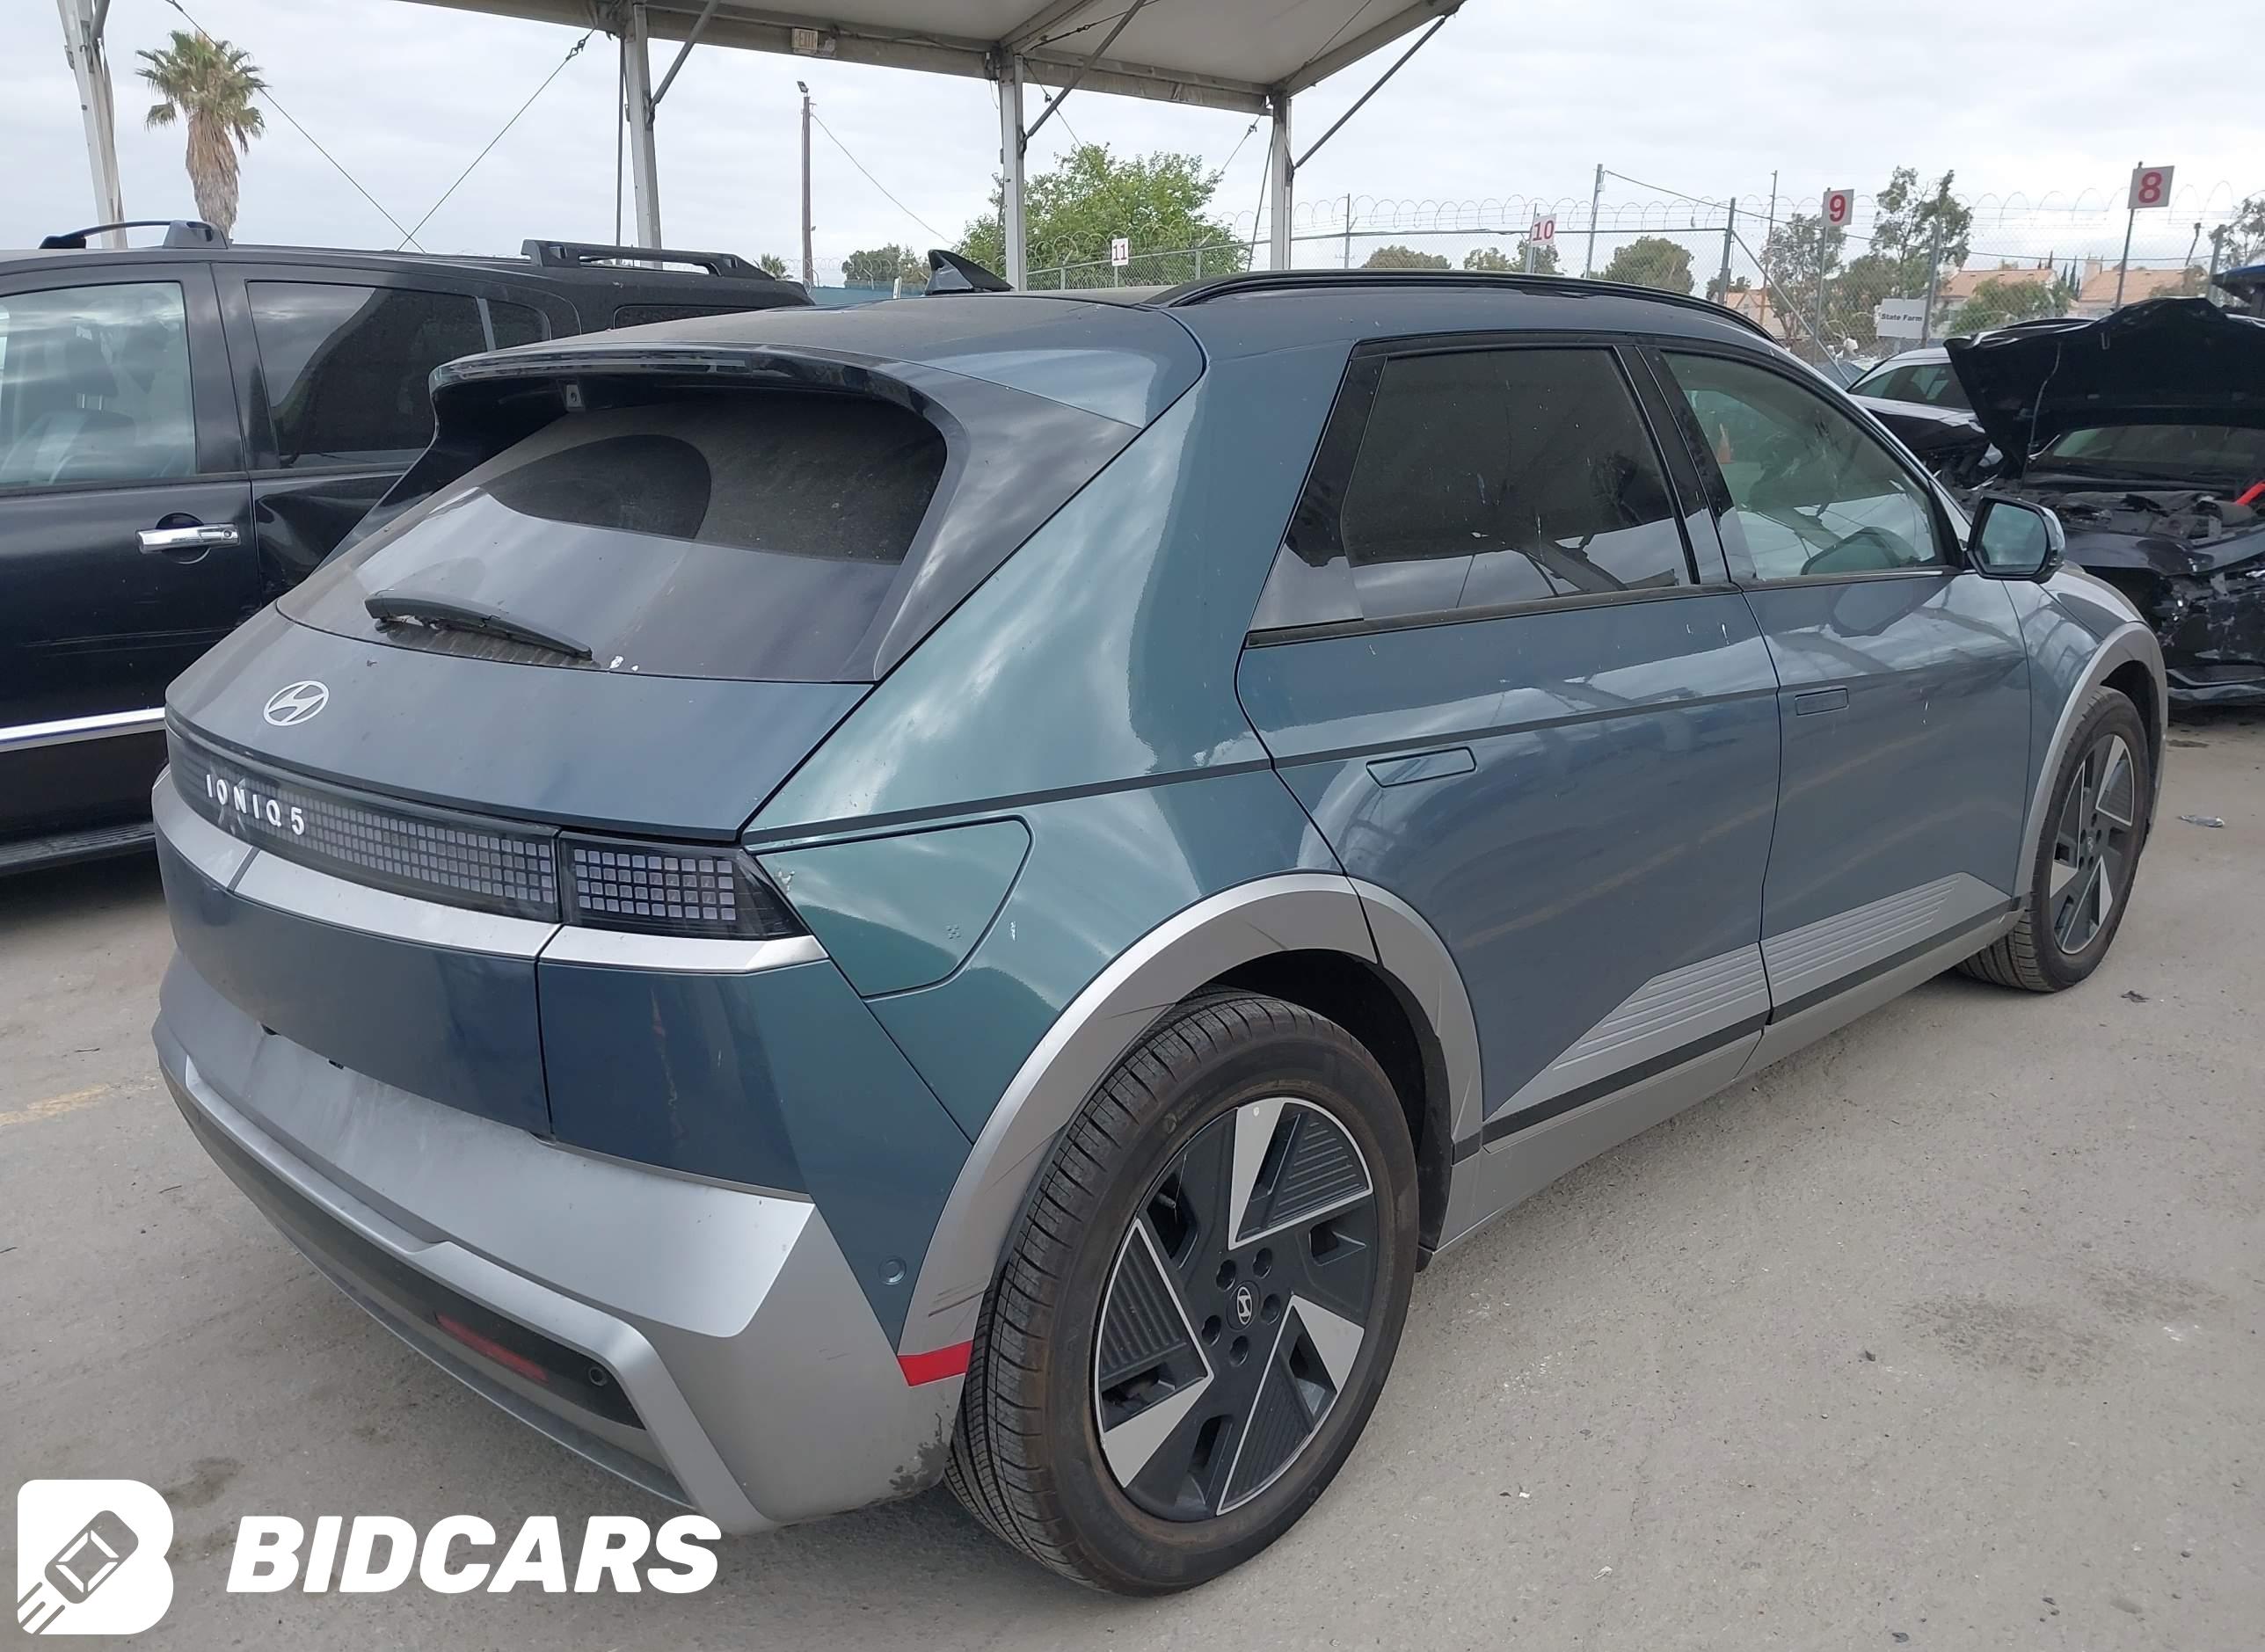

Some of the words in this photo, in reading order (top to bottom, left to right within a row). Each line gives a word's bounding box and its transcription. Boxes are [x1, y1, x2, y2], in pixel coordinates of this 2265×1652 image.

[2138, 171, 2162, 203] 8
[1829, 194, 1846, 222] 9
[1533, 220, 1554, 241] 10
[1113, 244, 1127, 261] 11
[206, 774, 282, 827] IONIQ
[290, 806, 305, 835] 5
